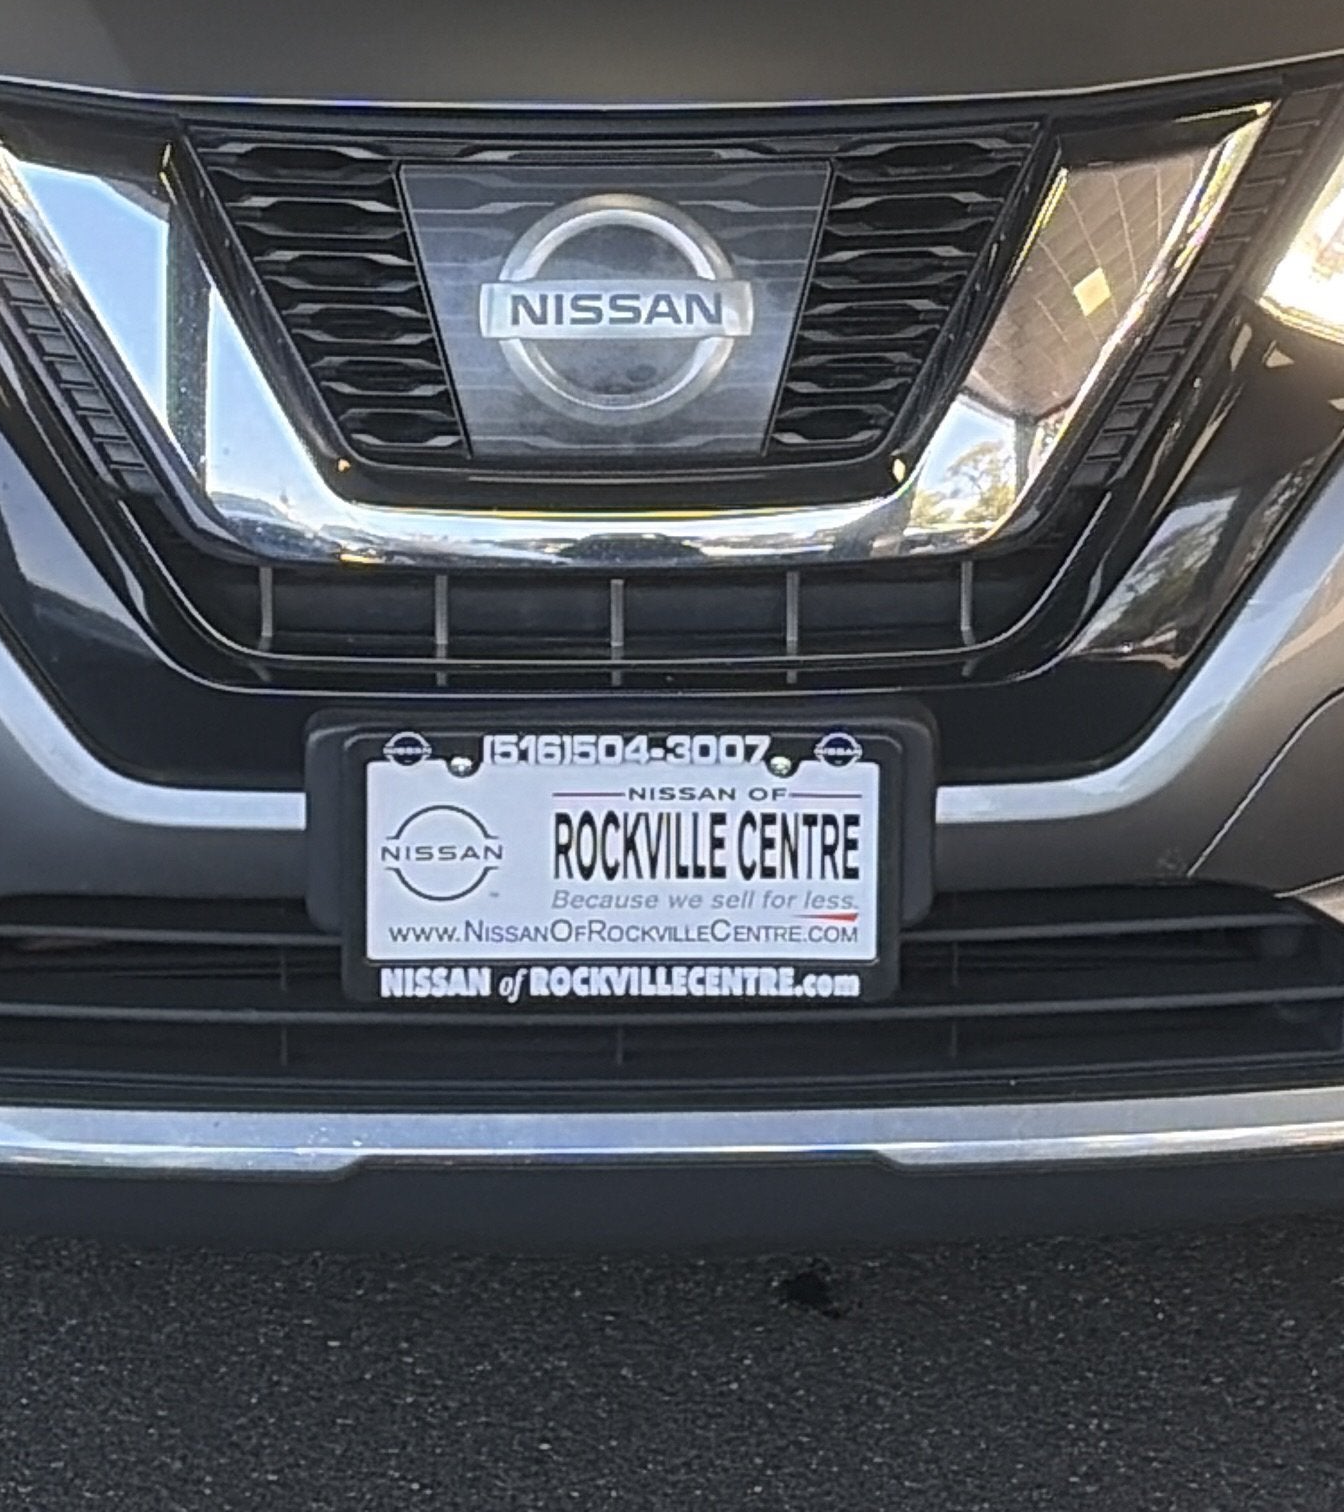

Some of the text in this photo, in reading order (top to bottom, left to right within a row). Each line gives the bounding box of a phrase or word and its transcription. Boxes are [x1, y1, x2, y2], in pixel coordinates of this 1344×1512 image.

[510, 293, 723, 326] NISSAN
[628, 786, 788, 802] NISSAN OF
[380, 843, 504, 862] NISSAN
[553, 809, 861, 882] ROCKVILLE CENTRE
[551, 889, 859, 911] Because we sell for less.
[380, 966, 861, 1004] NISSAN of ROCKVILLECENTRE.com
